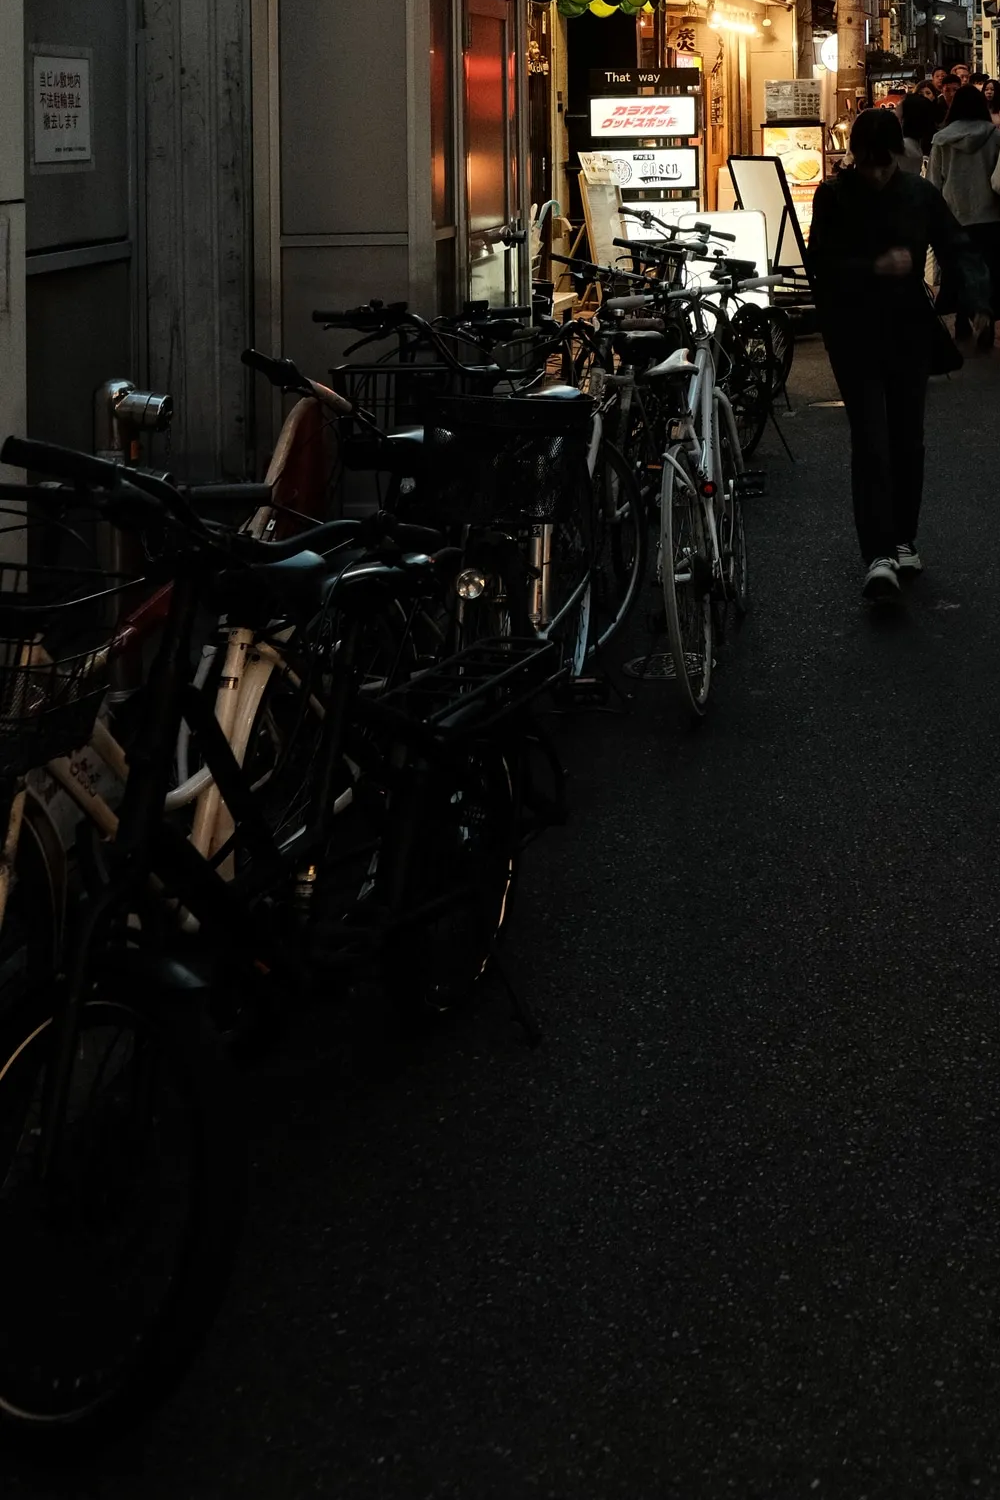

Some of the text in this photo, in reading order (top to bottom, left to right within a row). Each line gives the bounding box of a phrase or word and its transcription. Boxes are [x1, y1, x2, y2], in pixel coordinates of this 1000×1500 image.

[604, 71, 661, 84] That way
[611, 104, 671, 116] カラオケ
[601, 117, 678, 129] グッドスポット
